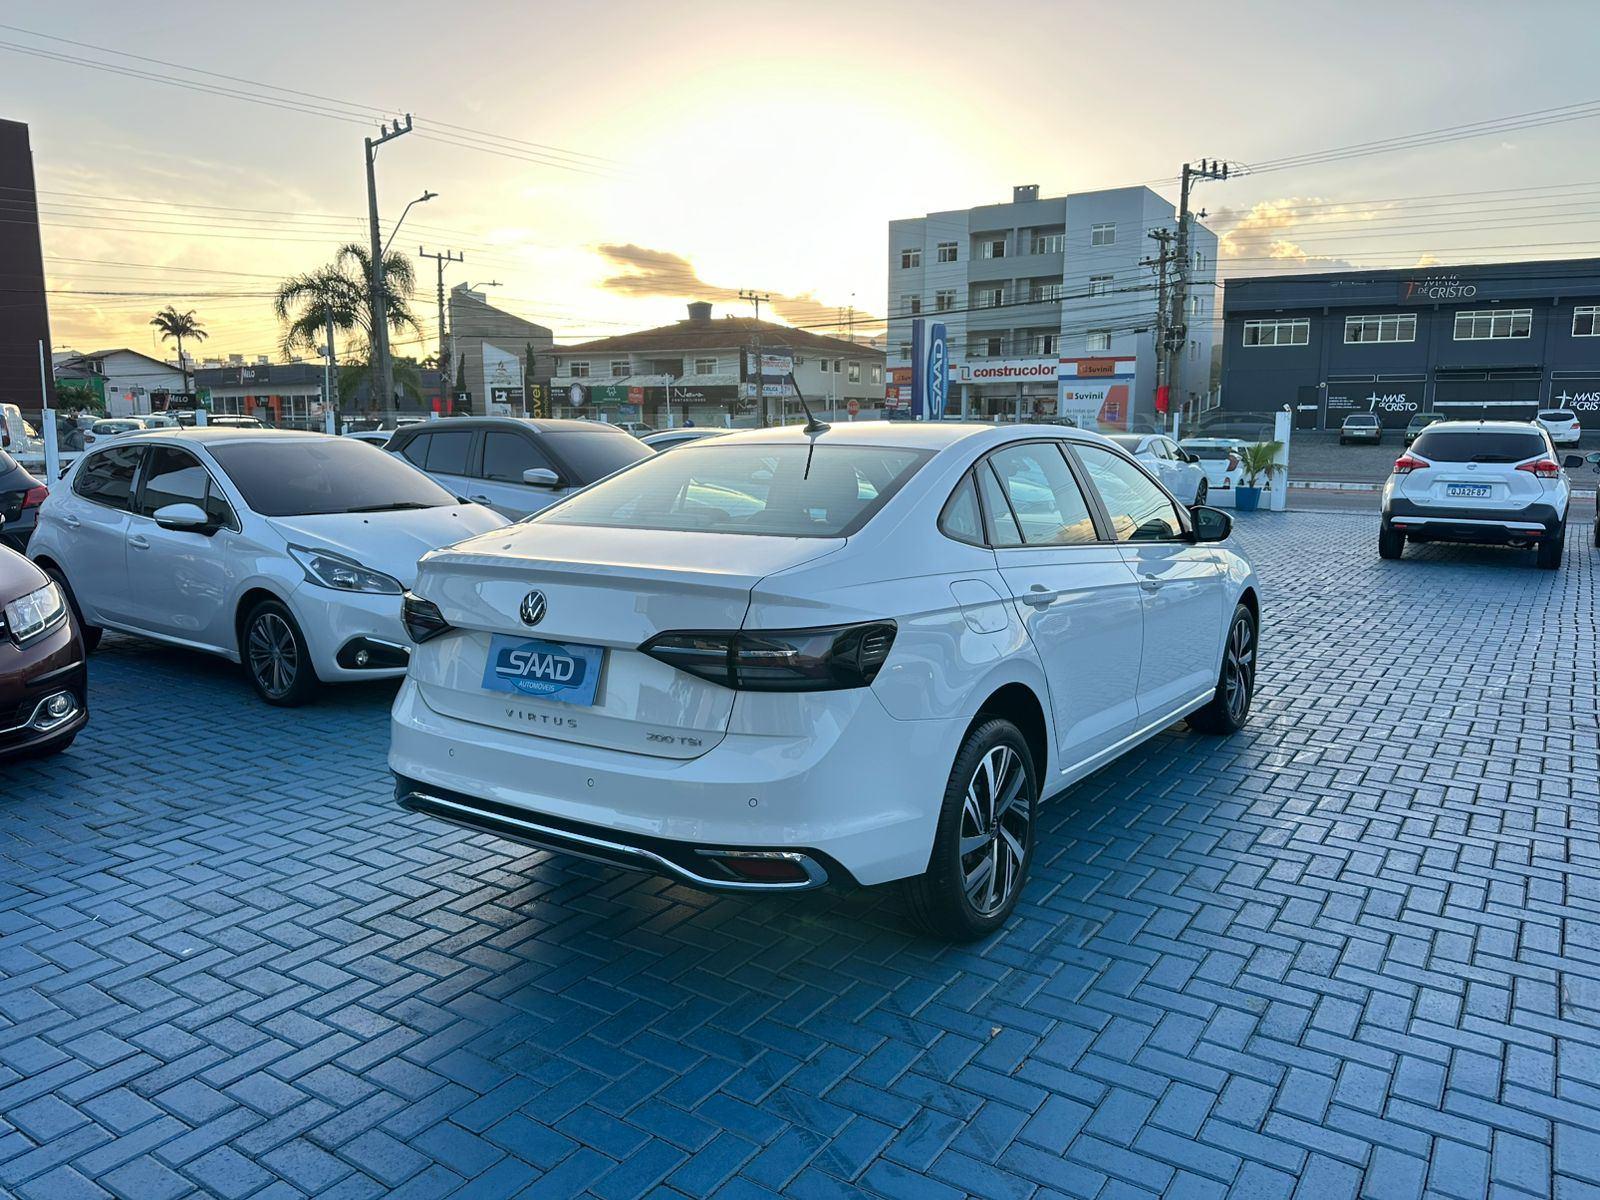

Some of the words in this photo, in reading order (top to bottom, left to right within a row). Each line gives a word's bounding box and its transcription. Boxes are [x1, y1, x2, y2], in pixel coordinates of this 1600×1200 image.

[1425, 274, 1461, 286] MAIS
[1428, 285, 1477, 299] CRISTO
[973, 364, 1057, 379] construcolor
[1088, 366, 1113, 374] Suvinil
[931, 338, 944, 421] SAAD
[1074, 391, 1104, 401] Suvinil
[1381, 393, 1406, 403] MAIS
[1573, 392, 1600, 401] MAIS
[1384, 401, 1418, 412] CRISTO
[495, 650, 575, 681] SAAD
[505, 708, 578, 729] VIRTUS
[646, 732, 675, 744] 200
